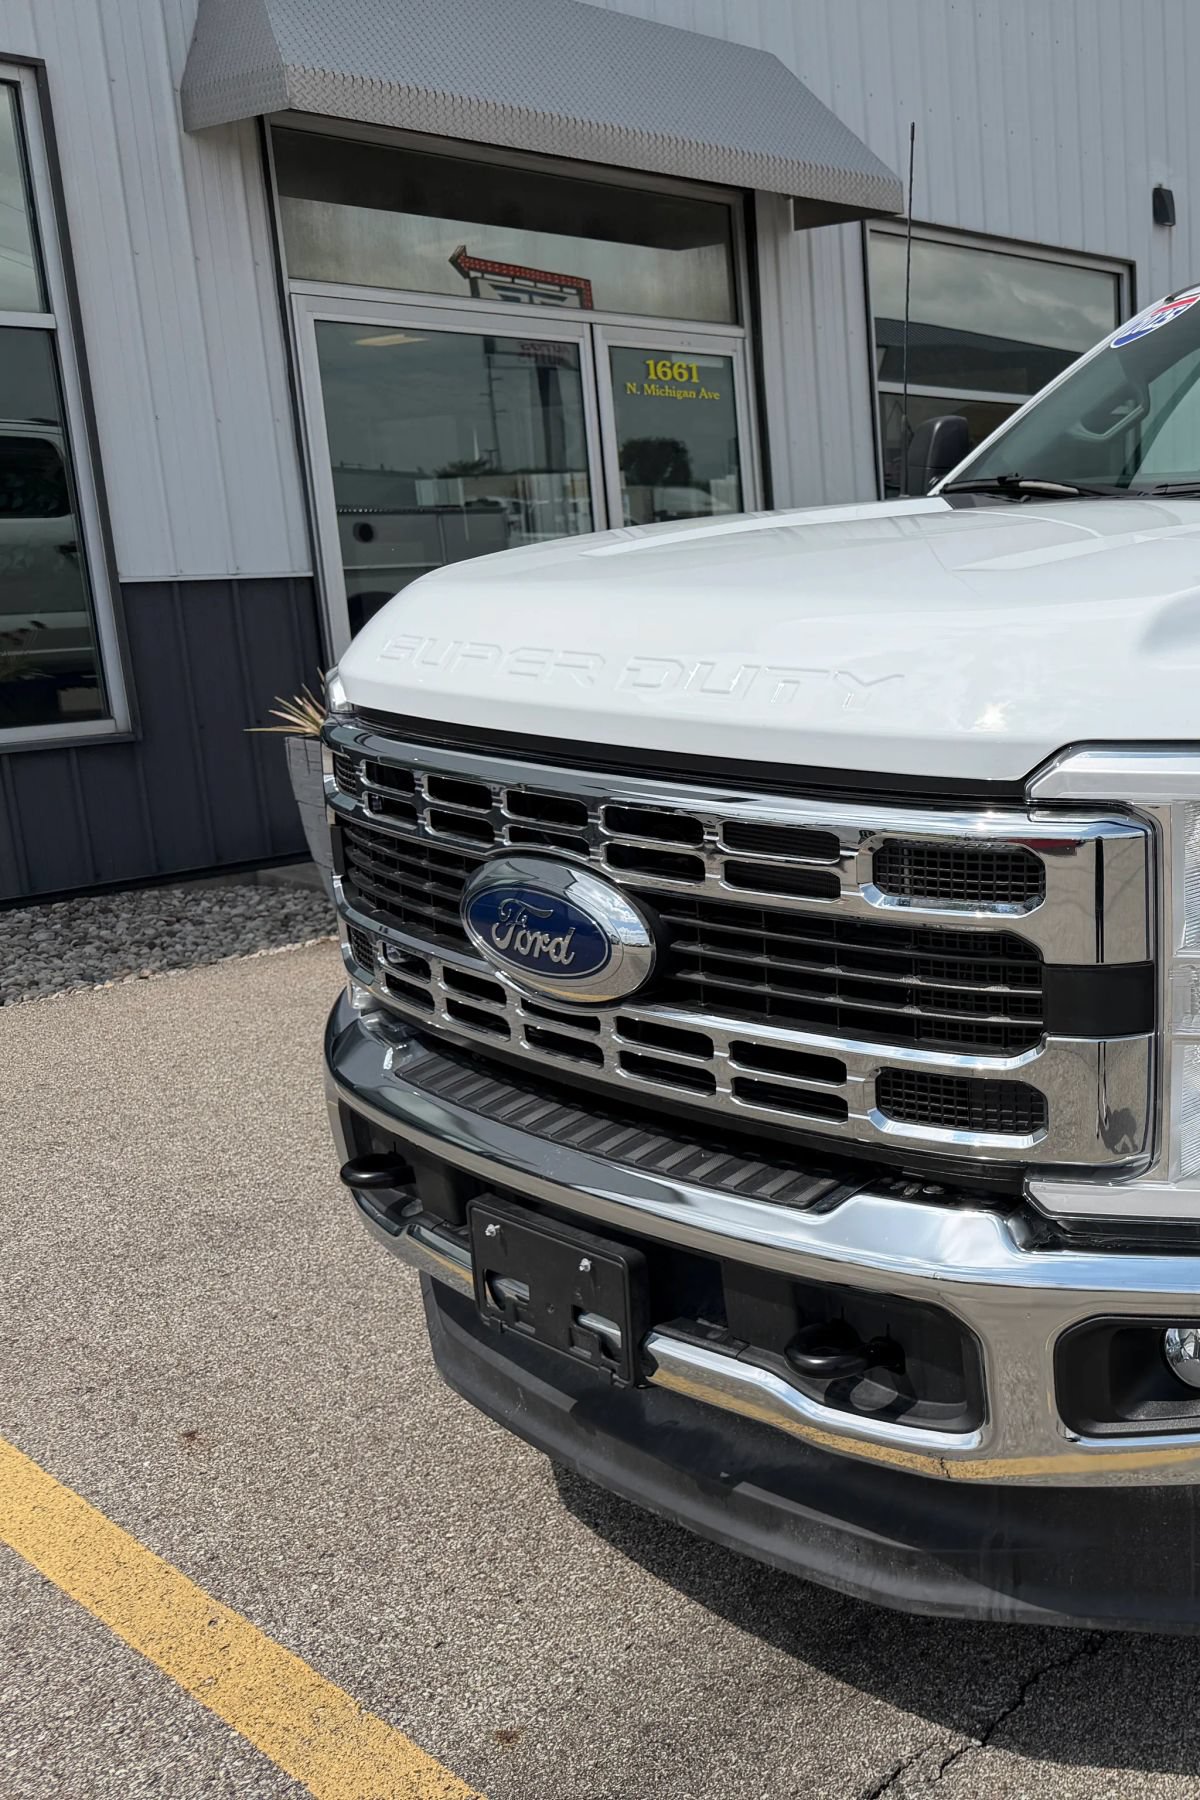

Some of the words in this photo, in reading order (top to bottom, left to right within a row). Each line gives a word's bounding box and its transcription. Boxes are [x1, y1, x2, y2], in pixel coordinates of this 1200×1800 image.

[626, 382, 641, 395] N.
[643, 383, 696, 400] Michigan
[699, 387, 721, 400] Ave
[645, 359, 700, 383] 1661
[376, 633, 607, 688] SUPER
[613, 656, 905, 711] DUTY
[491, 898, 575, 965] Ford
